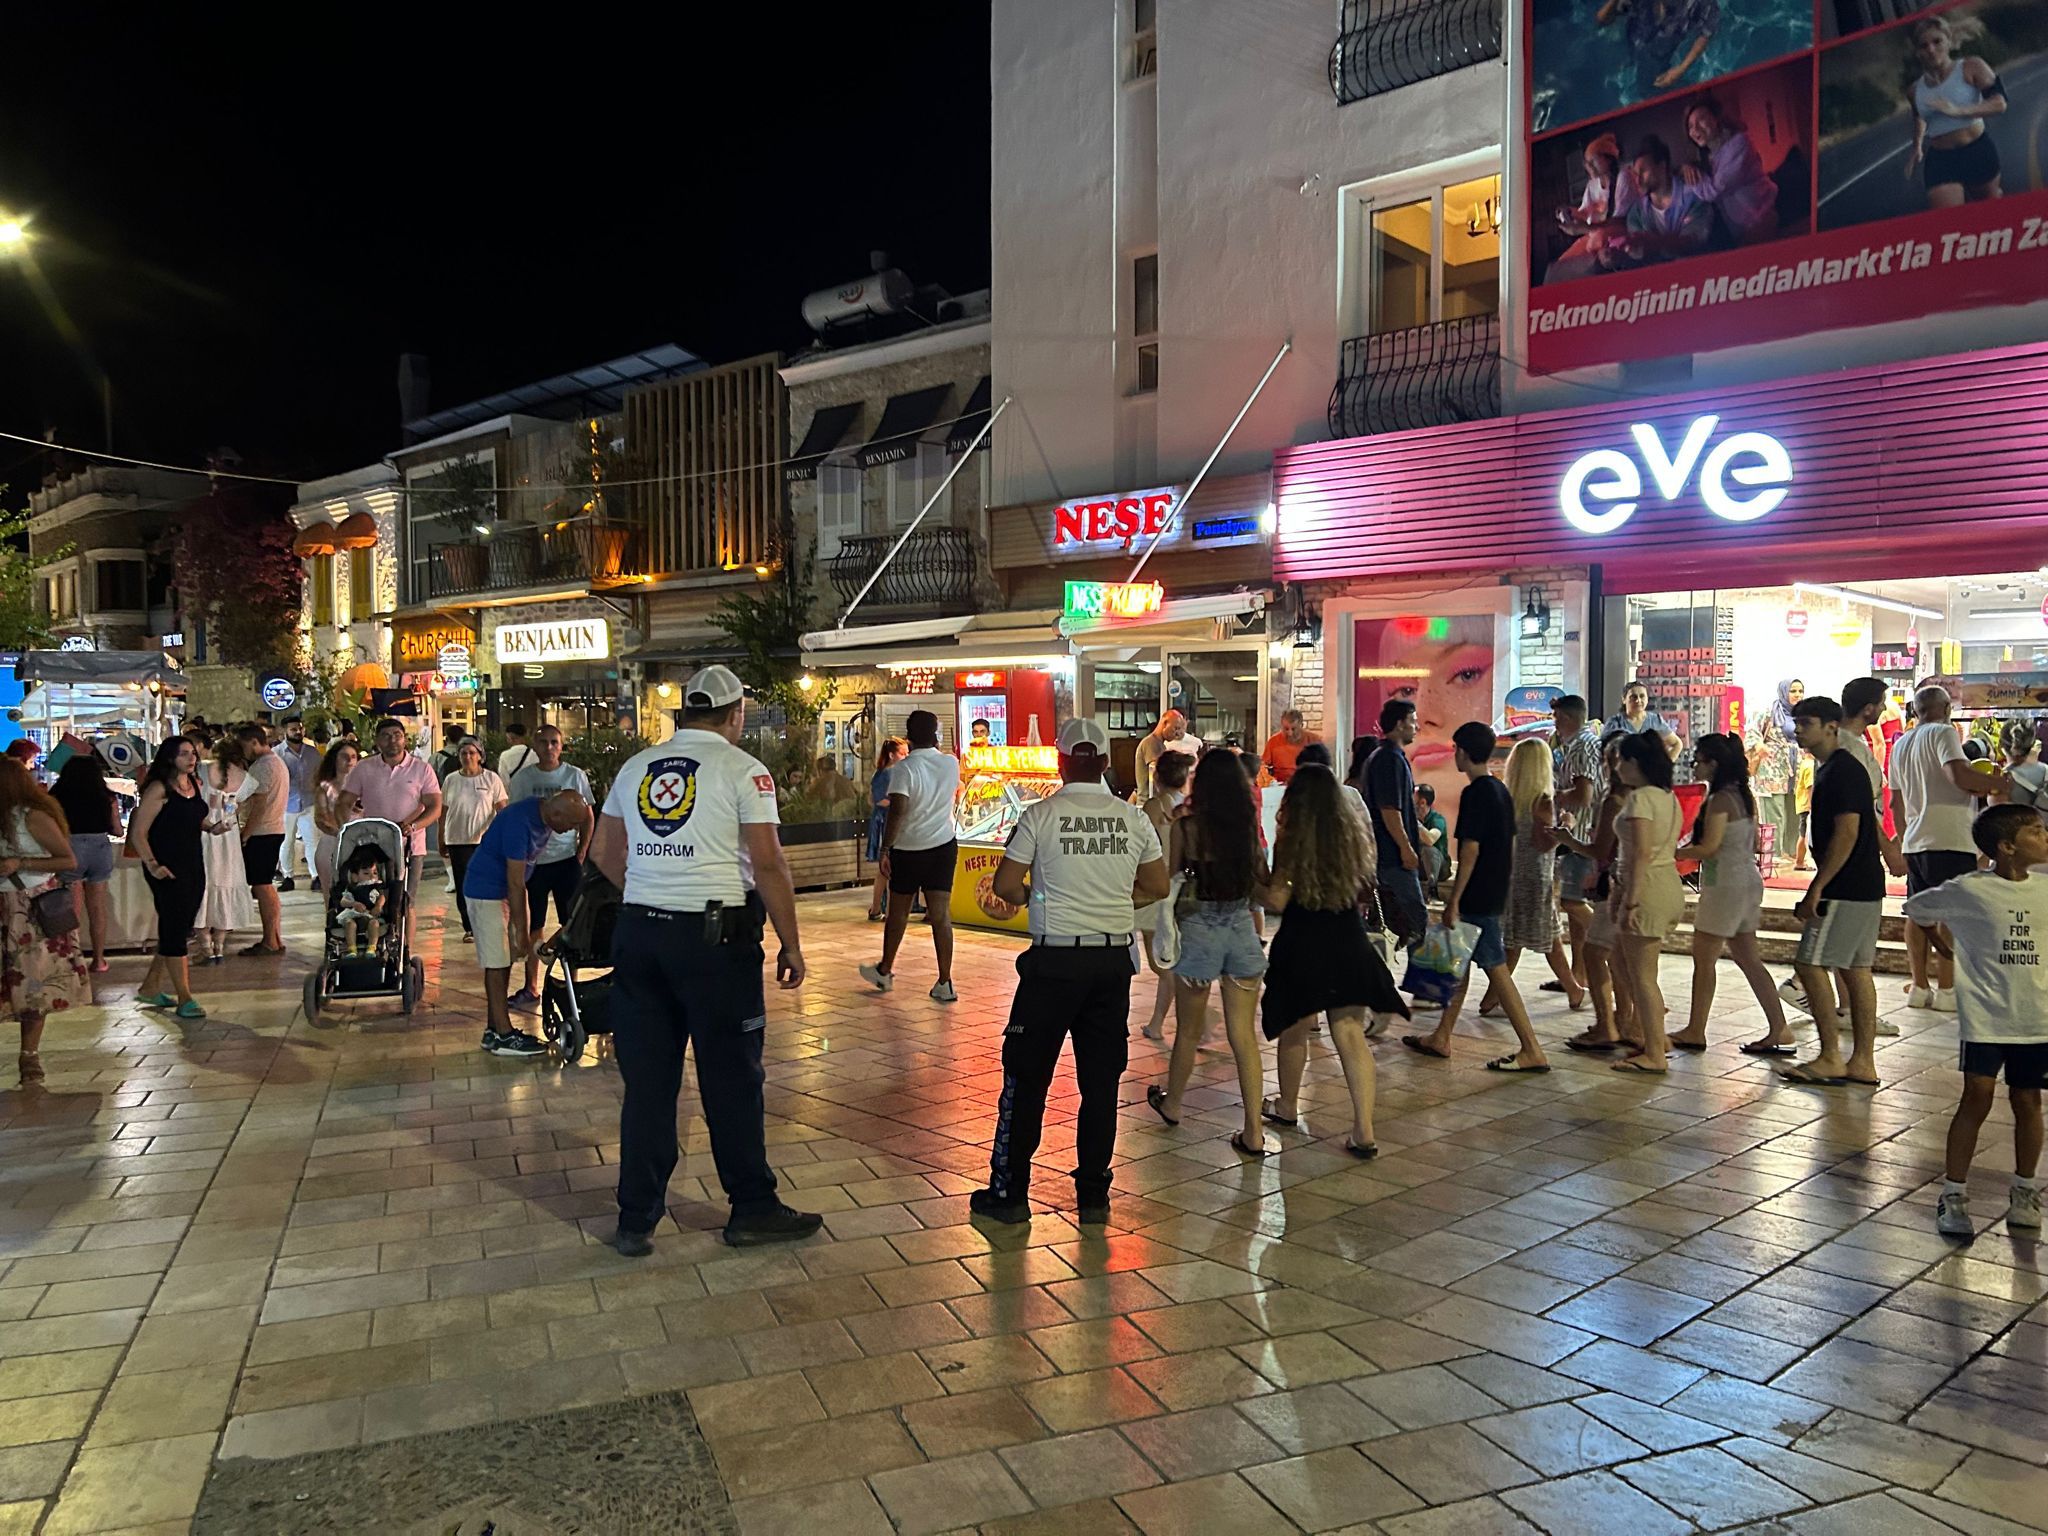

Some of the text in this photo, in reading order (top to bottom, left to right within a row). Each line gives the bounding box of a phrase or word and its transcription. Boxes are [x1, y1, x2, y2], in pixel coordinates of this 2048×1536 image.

[1529, 284, 1696, 335] Teknolojinin
[1699, 240, 1932, 306] MediaMarkt'la
[1940, 227, 2013, 264] Tam
[865, 448, 906, 466] BENJAMIN
[1560, 414, 1794, 534] eve
[1053, 493, 1175, 549] NEŞE
[1196, 519, 1259, 537] Pansiyon
[504, 625, 595, 656] BENJAMIN
[1525, 690, 1546, 700] eve
[1059, 816, 1128, 833] ZABITA
[636, 843, 694, 857] BODRUM
[1059, 833, 1129, 855] TRAFİK
[965, 855, 987, 872] NEŞE
[2010, 925, 2030, 936] FOR
[2003, 940, 2035, 951] BEING
[2000, 954, 2040, 965] UNIQUE
